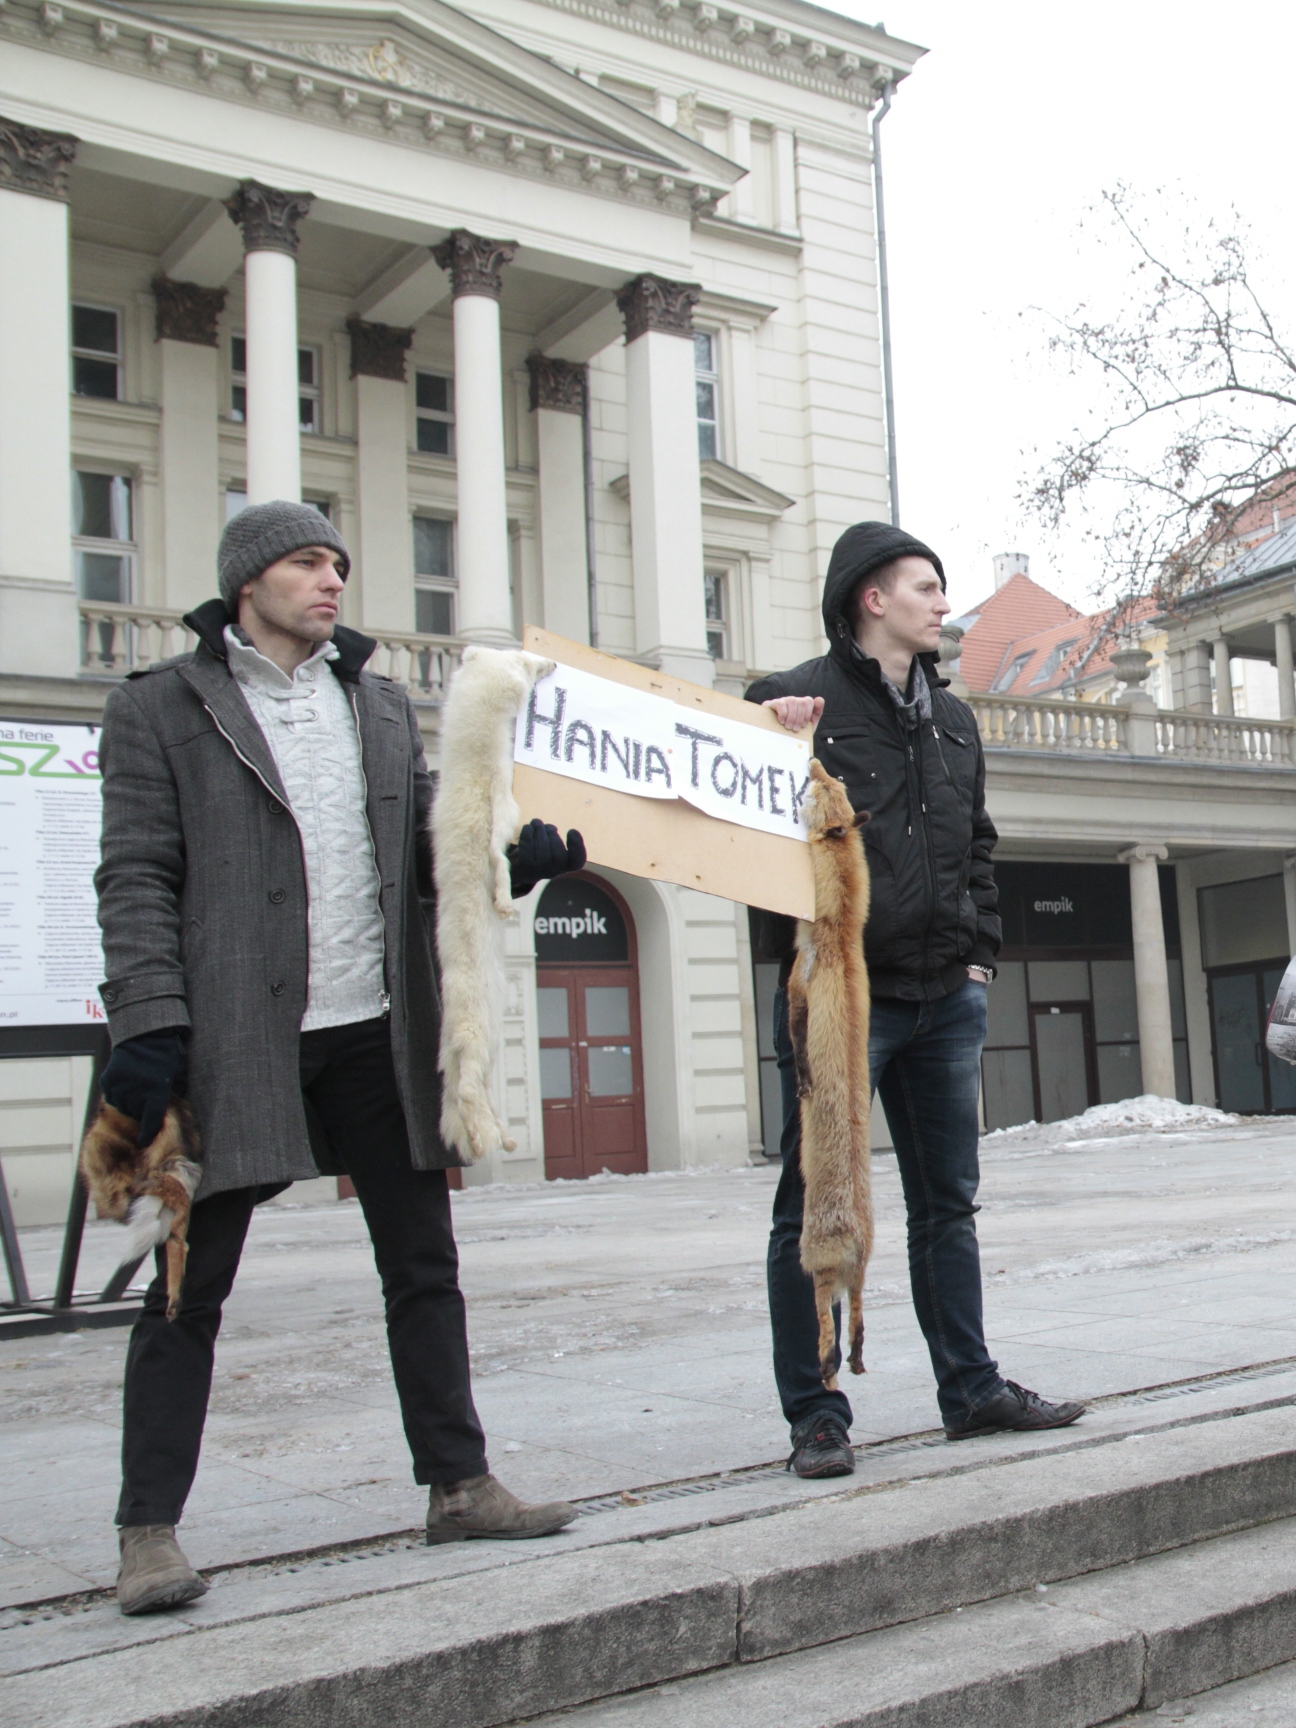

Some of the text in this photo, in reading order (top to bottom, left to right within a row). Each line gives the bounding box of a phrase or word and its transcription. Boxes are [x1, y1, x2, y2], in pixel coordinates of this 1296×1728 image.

[19, 728, 54, 742] ferie
[524, 684, 673, 789] HANIA
[674, 722, 809, 824] TOMEK
[1034, 896, 1074, 915] empik
[534, 908, 607, 939] empik
